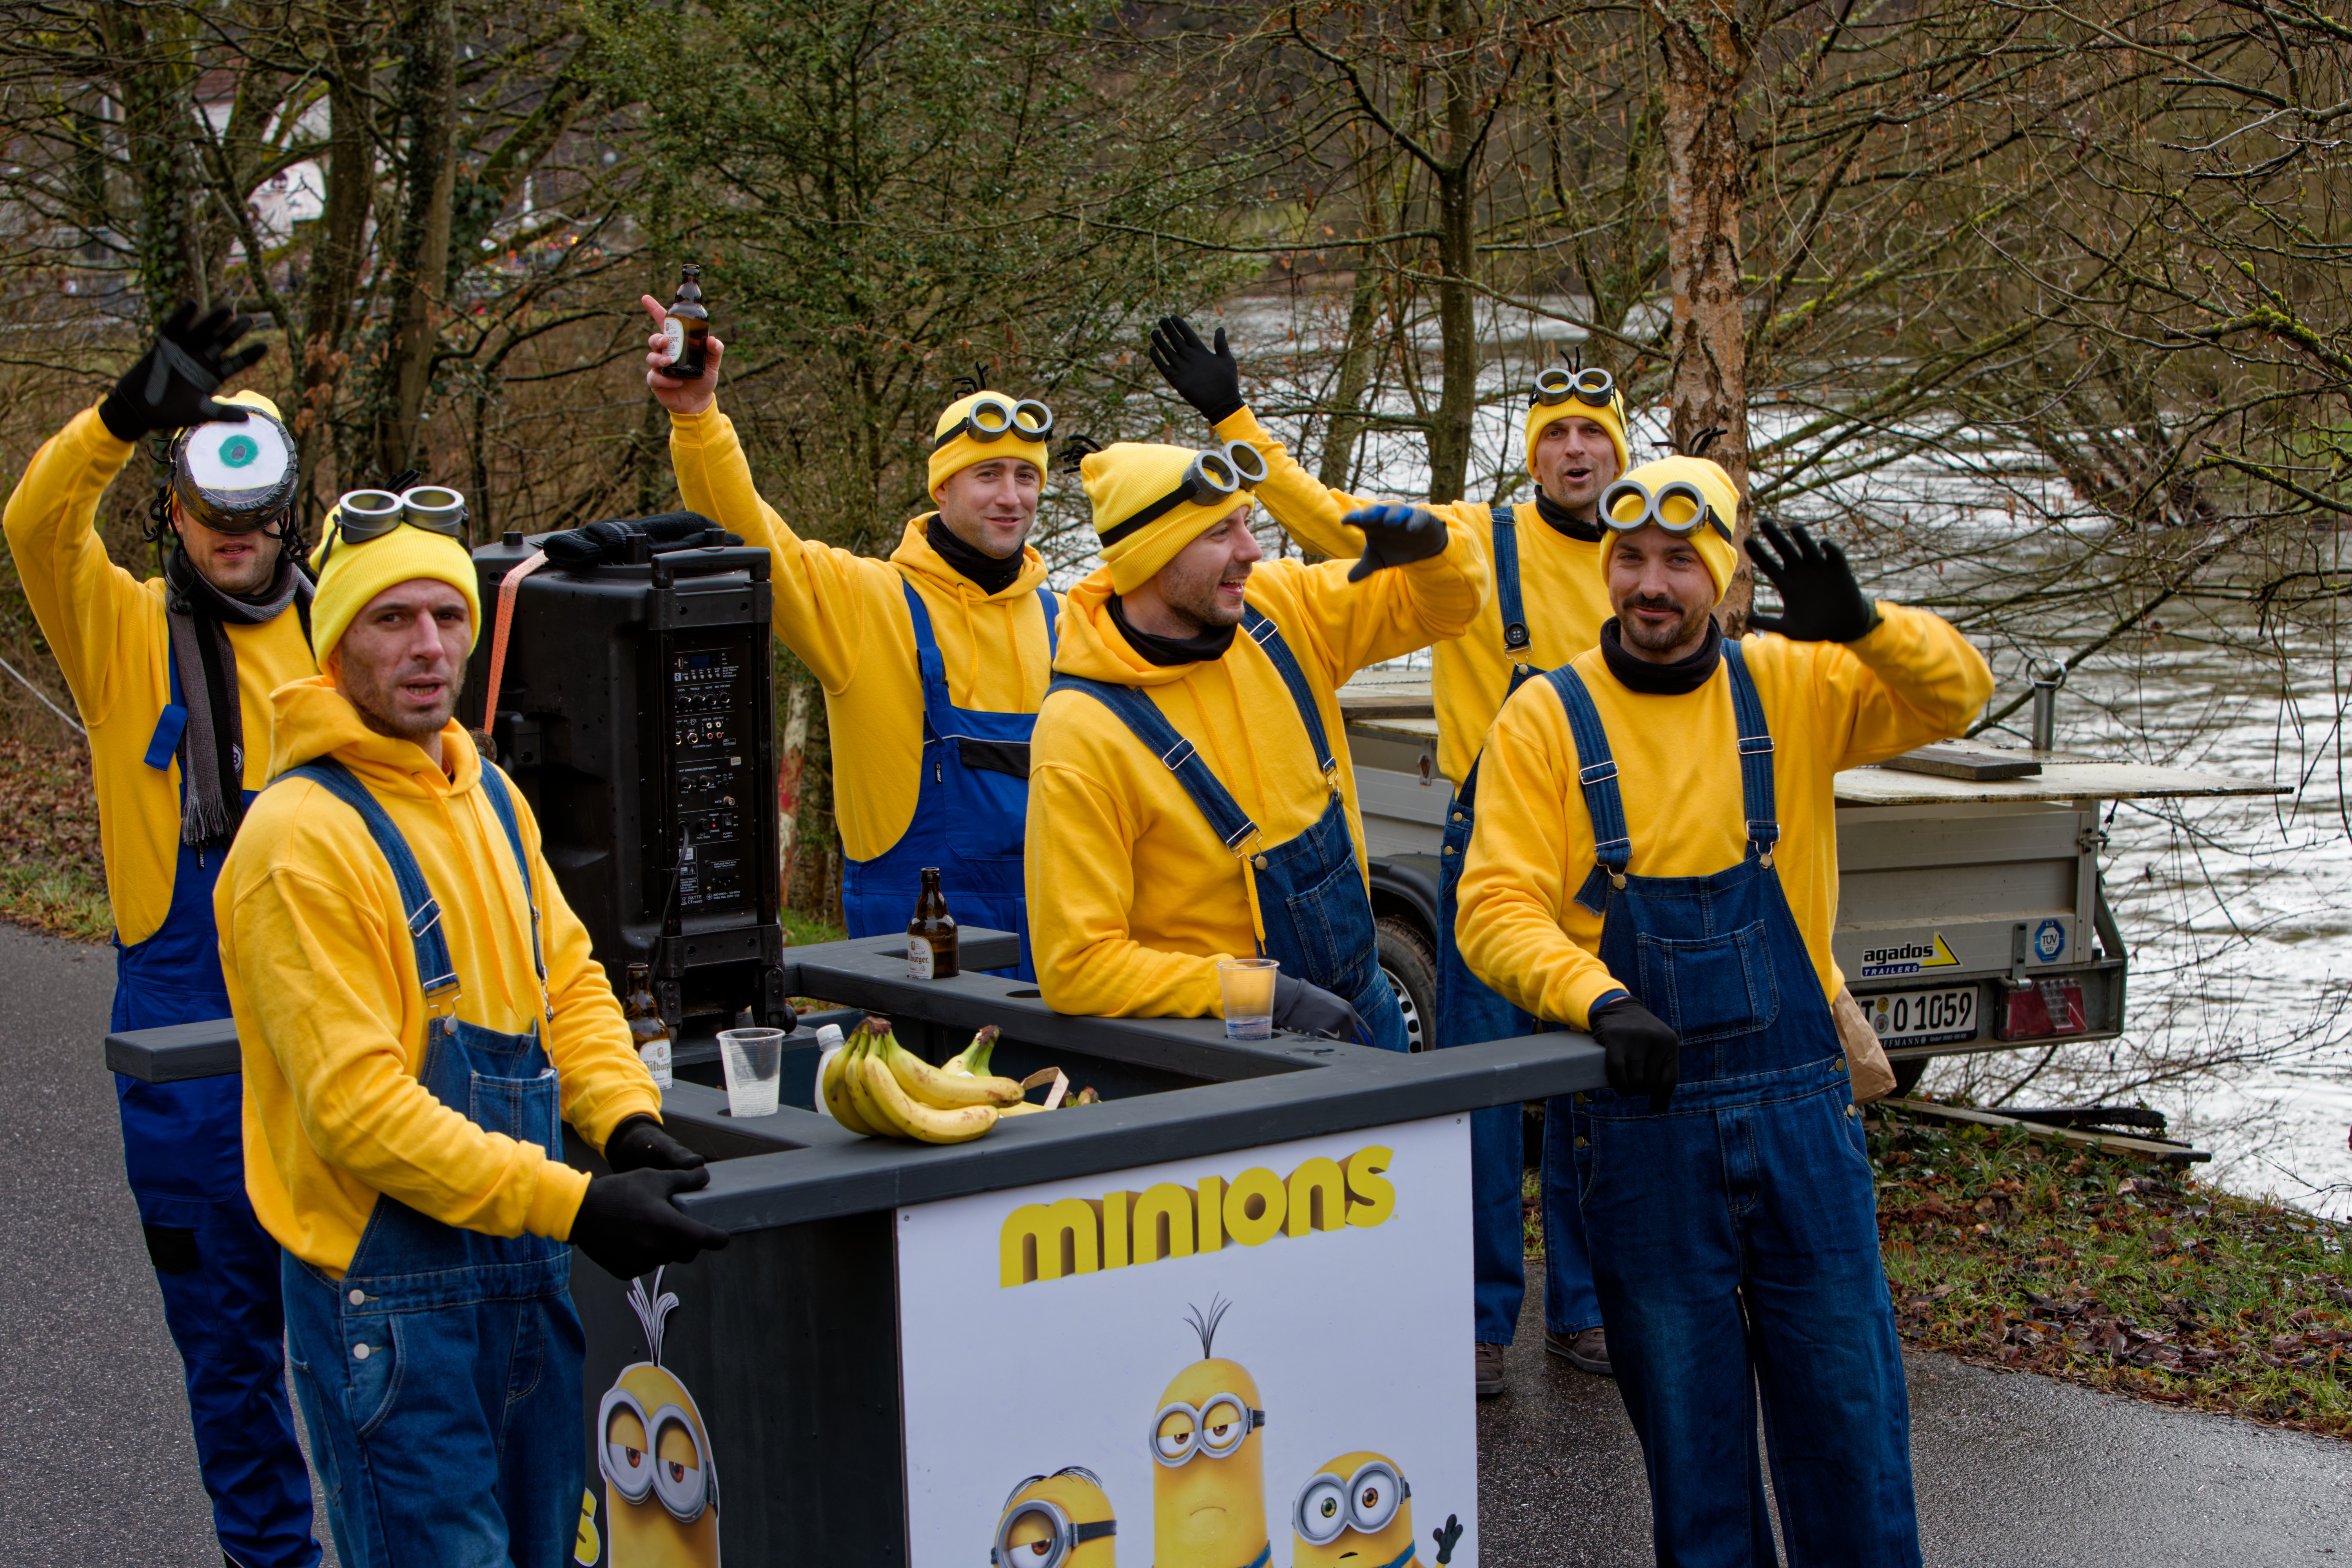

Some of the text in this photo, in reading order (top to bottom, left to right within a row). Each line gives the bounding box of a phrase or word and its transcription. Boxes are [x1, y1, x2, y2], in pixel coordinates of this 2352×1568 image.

[1864, 943, 1933, 965] agados
[1865, 965, 1918, 976] TRAILERS
[1914, 992, 1972, 1031] 1059
